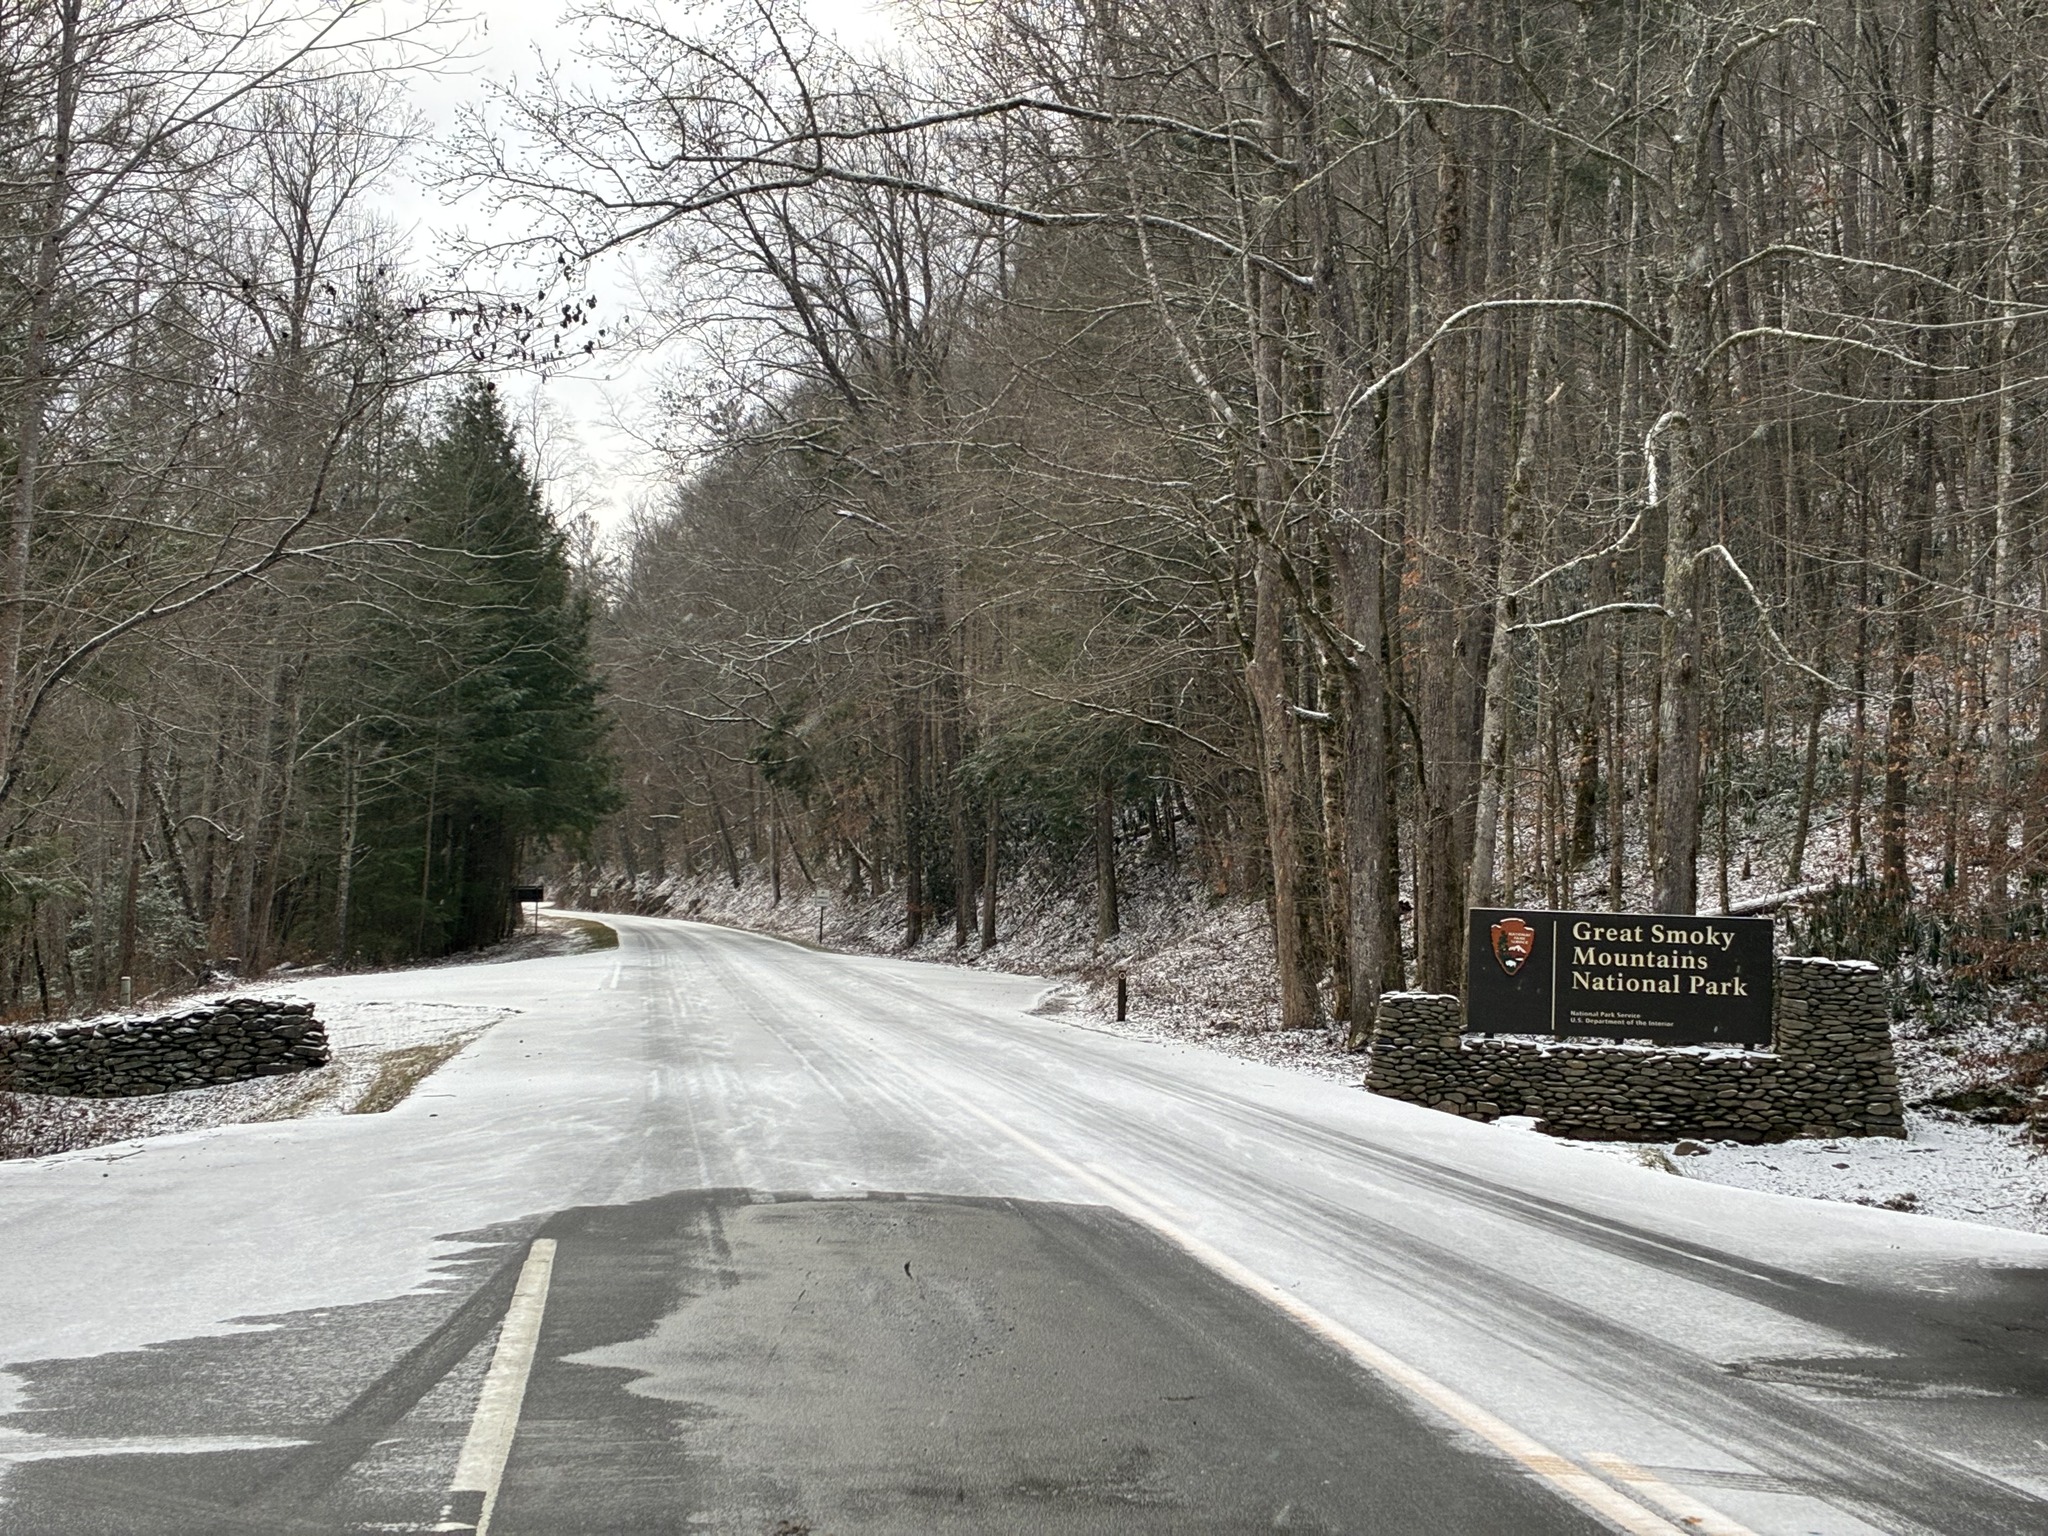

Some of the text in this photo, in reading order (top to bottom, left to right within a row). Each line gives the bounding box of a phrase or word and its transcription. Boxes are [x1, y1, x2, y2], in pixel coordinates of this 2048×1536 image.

[1572, 921, 1736, 952] Great Smoky
[1571, 946, 1708, 970] Mountains
[1571, 971, 1748, 997] National Park
[1617, 1011, 1641, 1019] Service
